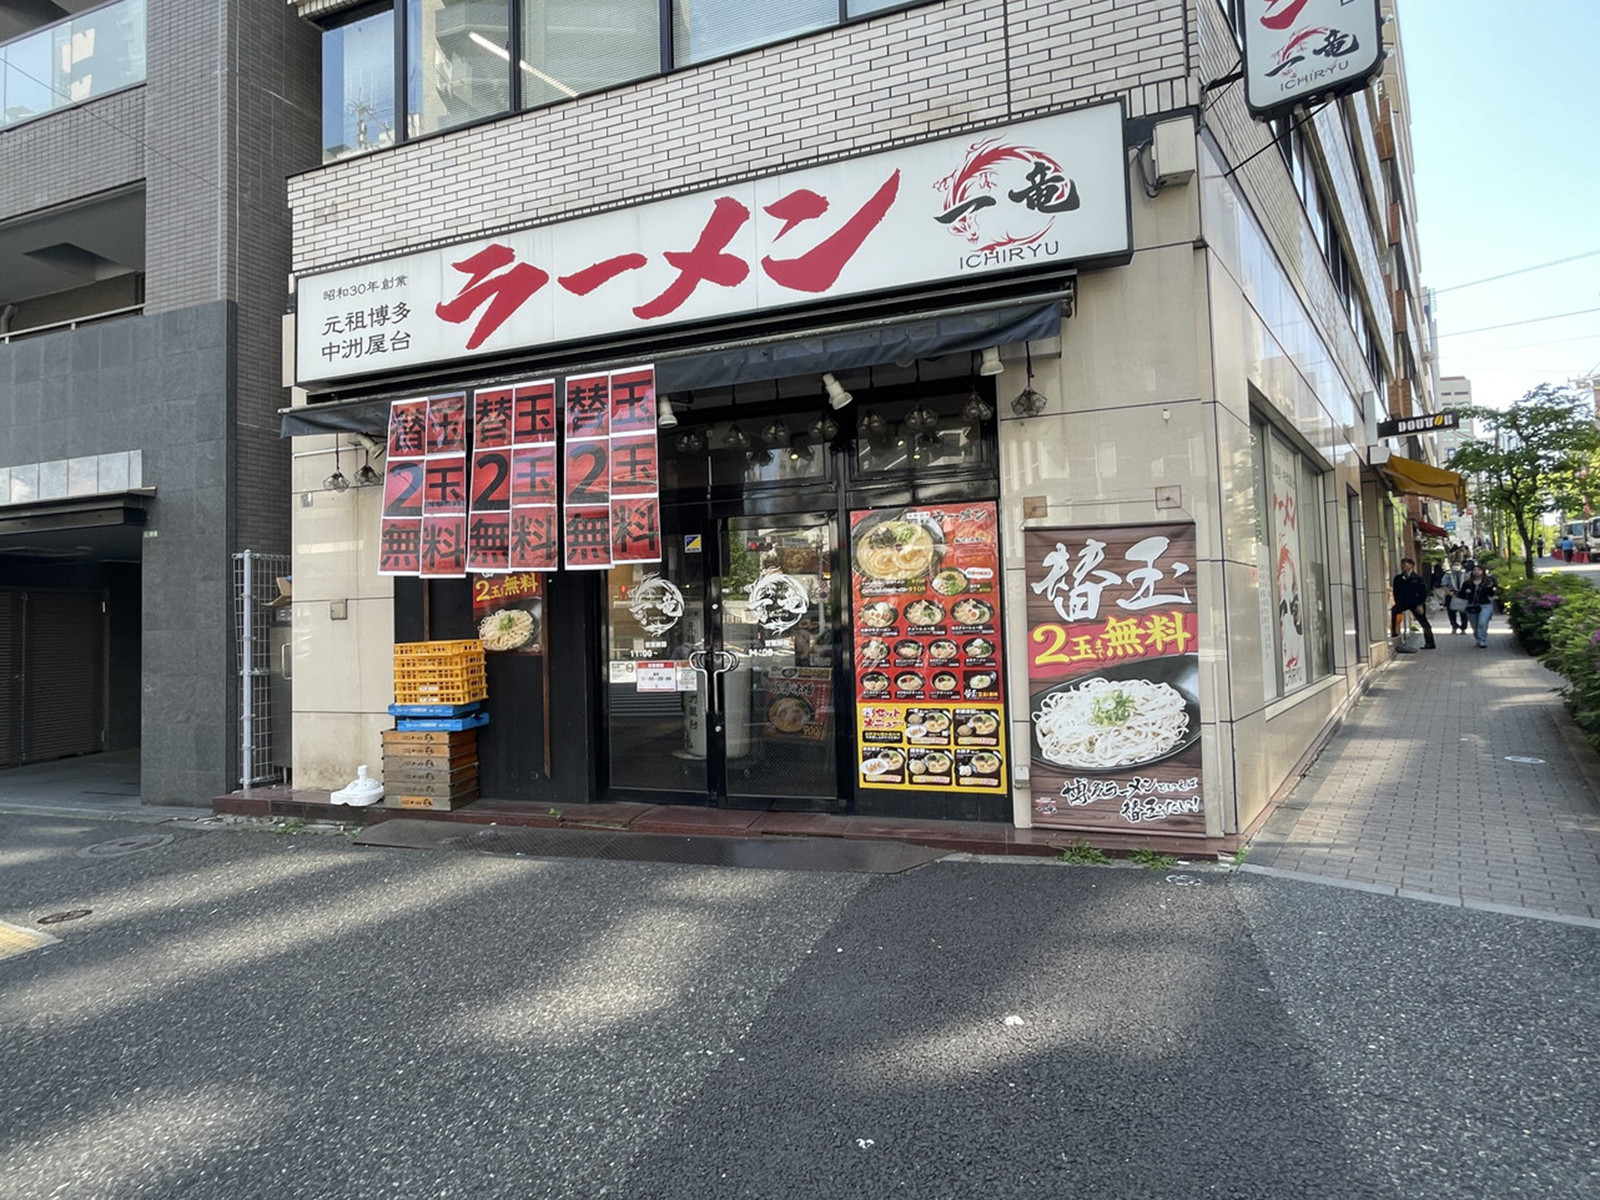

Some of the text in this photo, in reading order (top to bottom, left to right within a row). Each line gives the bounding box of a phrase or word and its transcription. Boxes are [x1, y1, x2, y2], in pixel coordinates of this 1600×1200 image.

[1280, 60, 1349, 92] ICHIRYU
[435, 168, 900, 350] ラーメン
[959, 241, 1059, 270] ICHIRYU
[323, 274, 408, 301] 昭和30年創業
[322, 301, 411, 336] 元祖博多
[321, 330, 411, 362] 中洲屋台
[390, 410, 464, 451] 替玉
[476, 394, 554, 443] 替玉
[567, 380, 656, 431] 替玉
[1398, 414, 1453, 433] DOUTOR
[386, 462, 464, 516] 2玉
[476, 453, 555, 510] 2玉
[567, 443, 656, 503] 2玉
[382, 520, 464, 567] 無料
[471, 513, 556, 565] 無料
[567, 503, 660, 560] 無料
[1031, 536, 1192, 621] 替玉
[1033, 611, 1190, 666] 2玉まで無料
